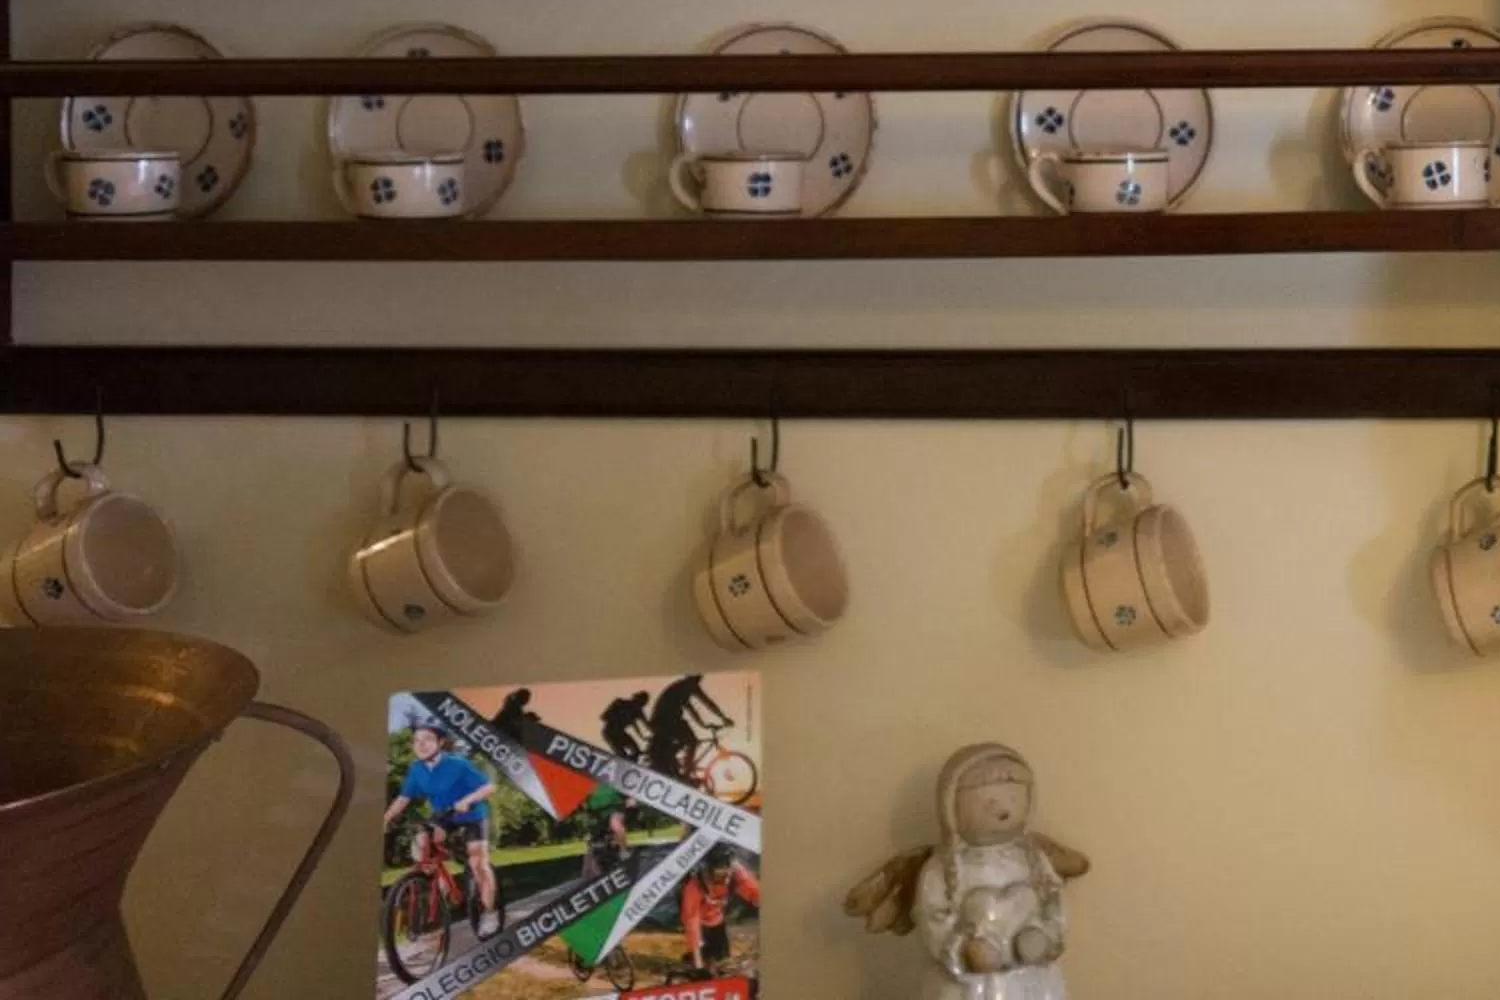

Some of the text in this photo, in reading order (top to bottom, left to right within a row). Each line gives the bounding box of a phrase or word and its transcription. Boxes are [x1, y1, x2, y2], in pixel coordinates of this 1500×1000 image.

[436, 697, 524, 777] NOLEGGIO
[547, 735, 746, 838] PISTA CICLABILE
[407, 867, 632, 1000] OLEGGIO BICILETTE
[622, 868, 681, 925] RENTAL
